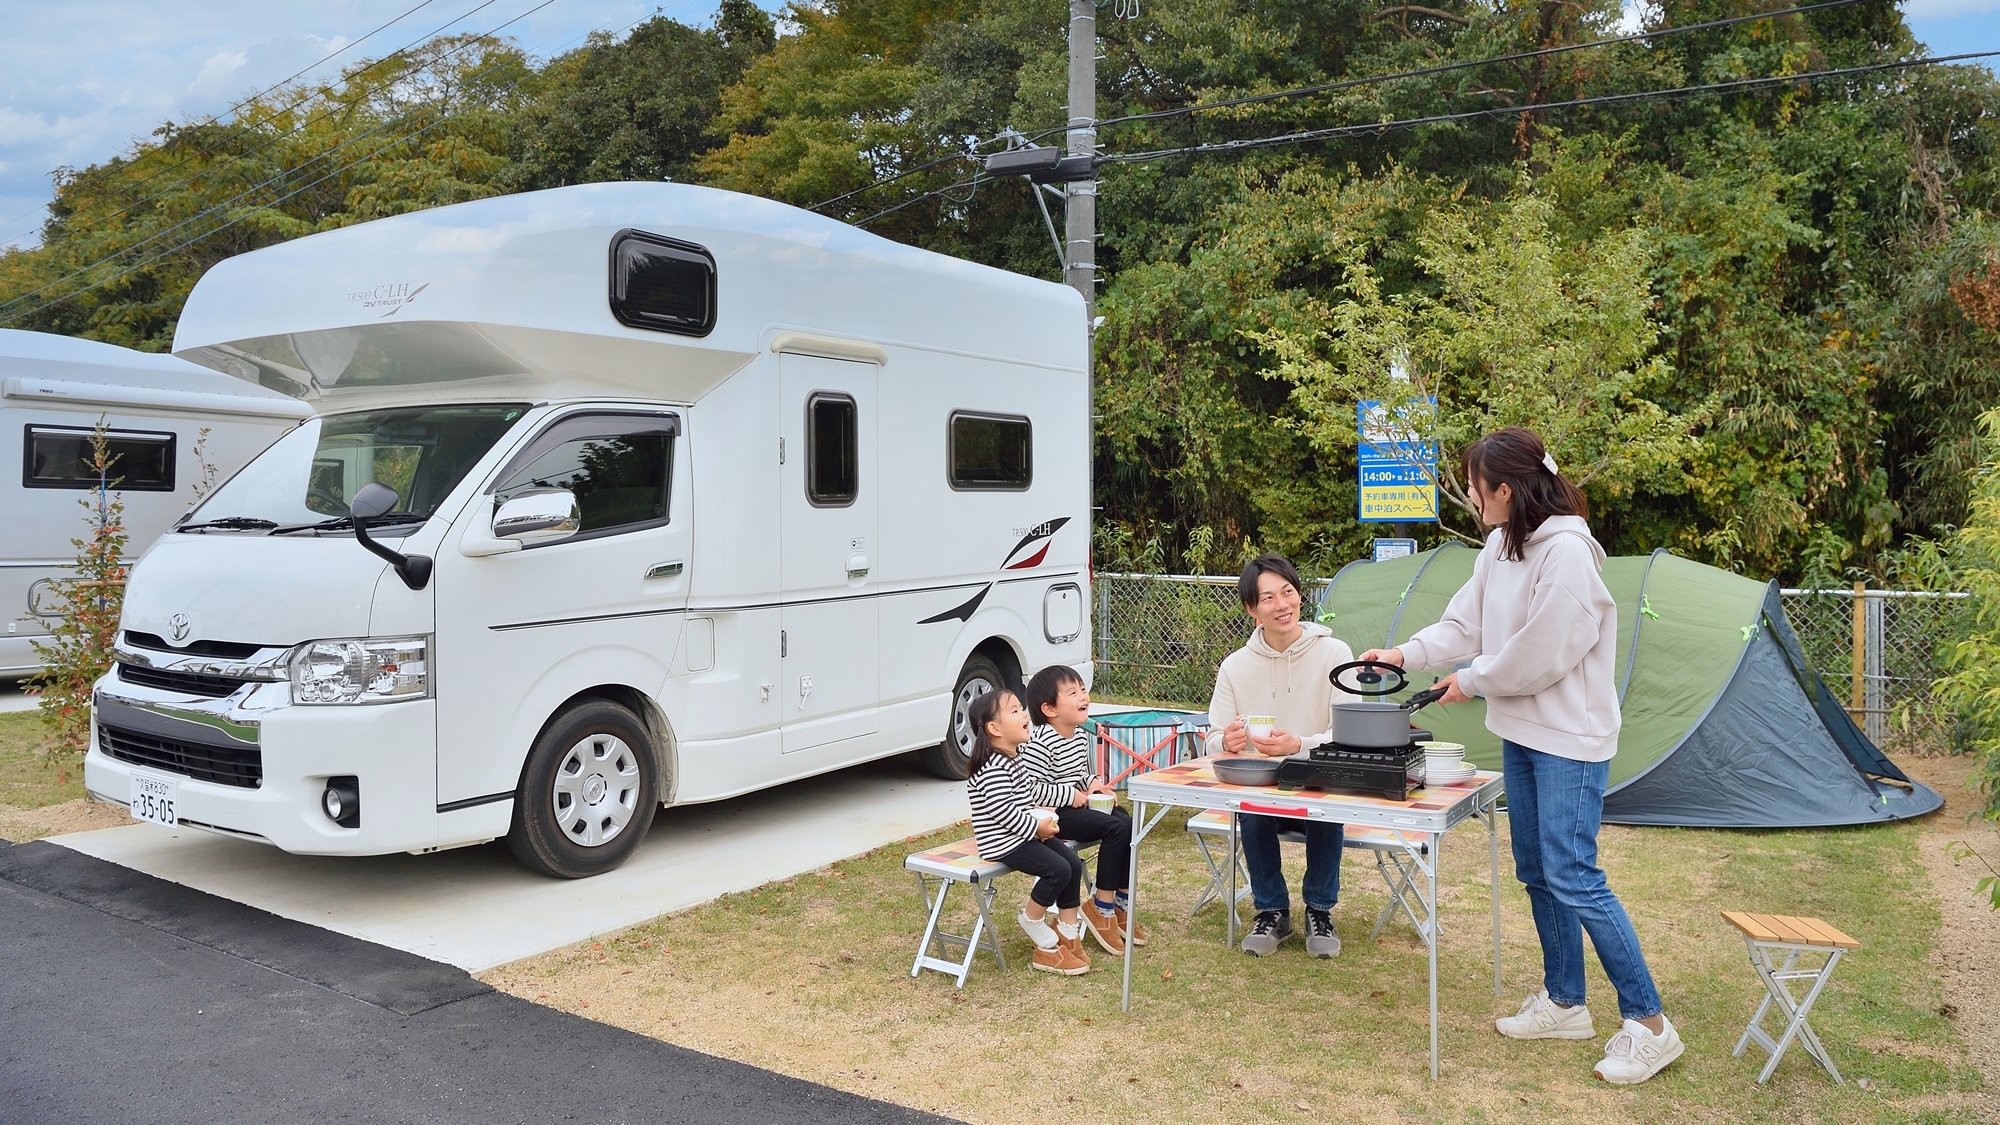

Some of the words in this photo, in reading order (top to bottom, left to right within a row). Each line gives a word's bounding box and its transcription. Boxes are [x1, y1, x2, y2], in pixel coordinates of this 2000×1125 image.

[374, 282, 410, 300] C-LH
[1363, 471, 1392, 482] 14:00
[1365, 503, 1432, 513] 車中泊スペース
